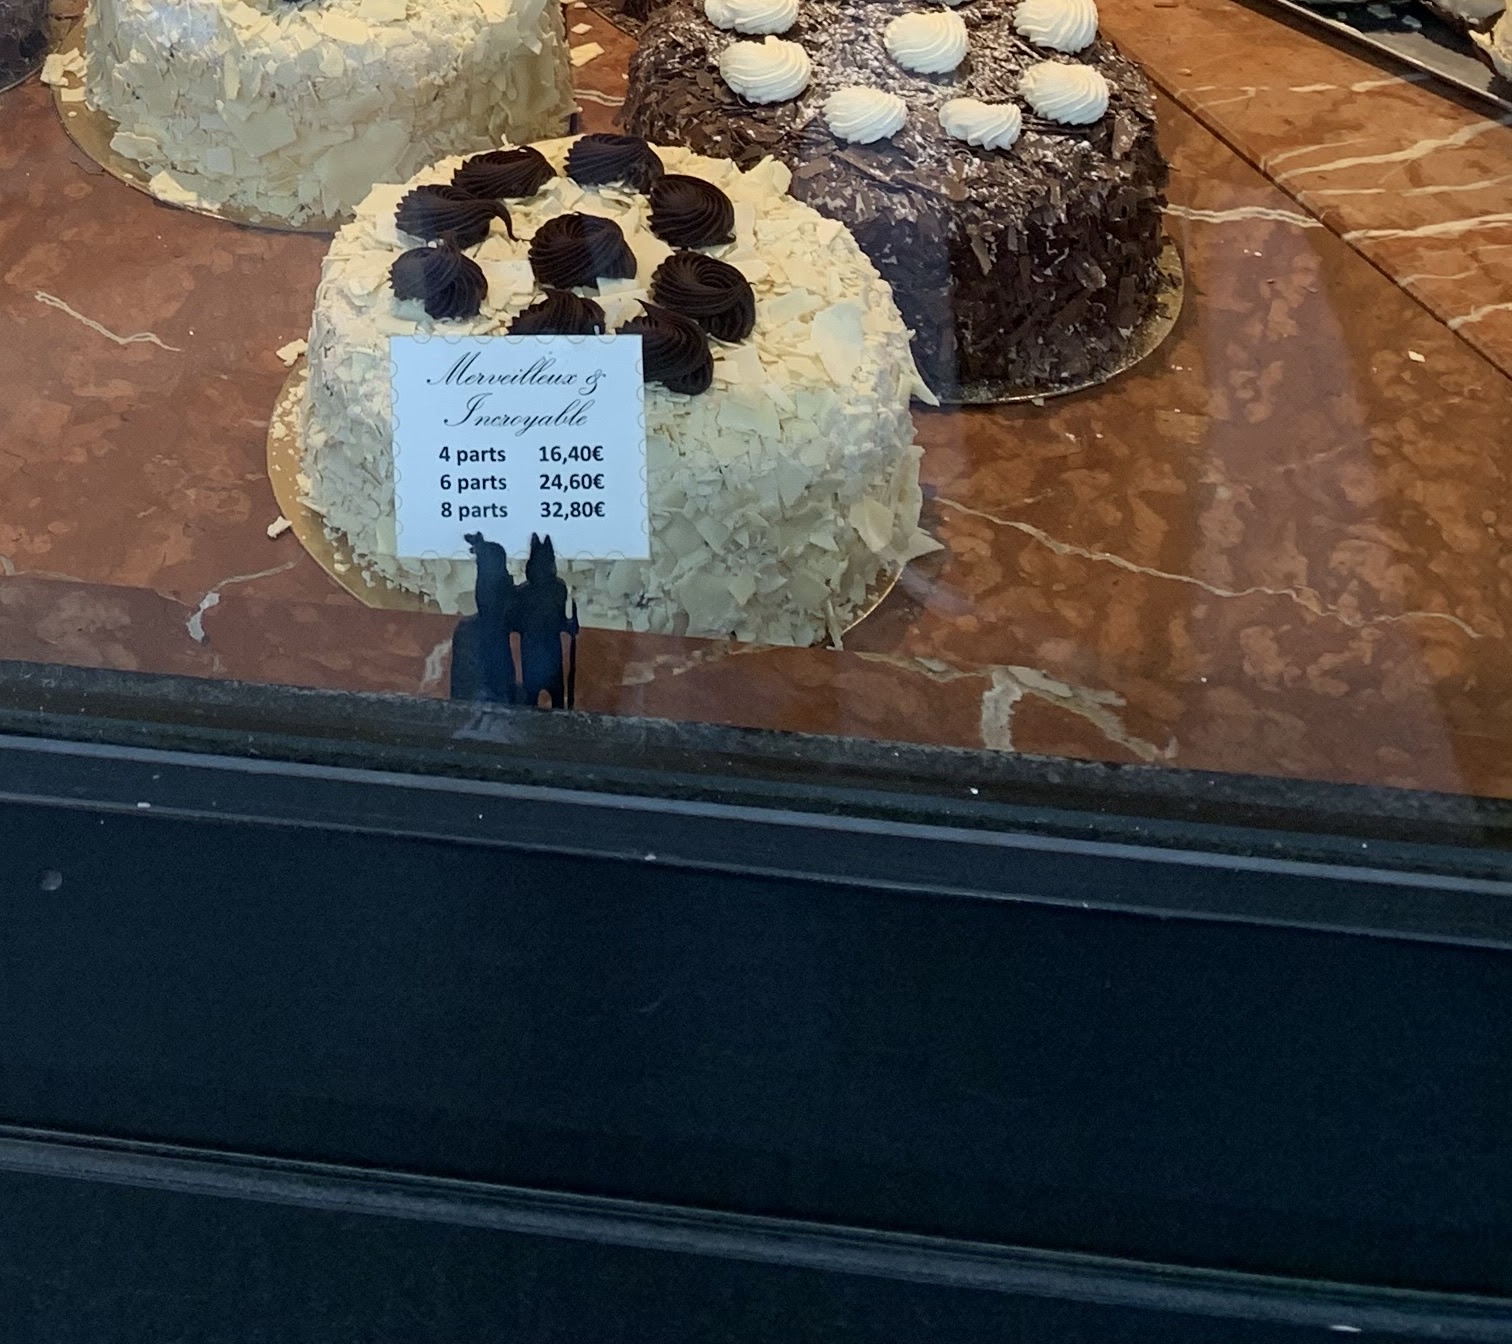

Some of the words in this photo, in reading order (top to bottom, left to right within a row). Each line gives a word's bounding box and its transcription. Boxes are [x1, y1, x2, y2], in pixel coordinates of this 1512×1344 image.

[426, 350, 578, 387] Merveilleux
[578, 368, 607, 397] &
[443, 392, 596, 438] Incroyable
[439, 446, 451, 463] 4
[456, 446, 506, 466] parts
[538, 445, 605, 465] 16,40€
[440, 474, 452, 491] 6
[457, 474, 508, 494] parts
[539, 473, 606, 493] 24,60€
[441, 501, 453, 518] 8
[458, 502, 509, 522] parts
[540, 501, 606, 522] 32,80€
